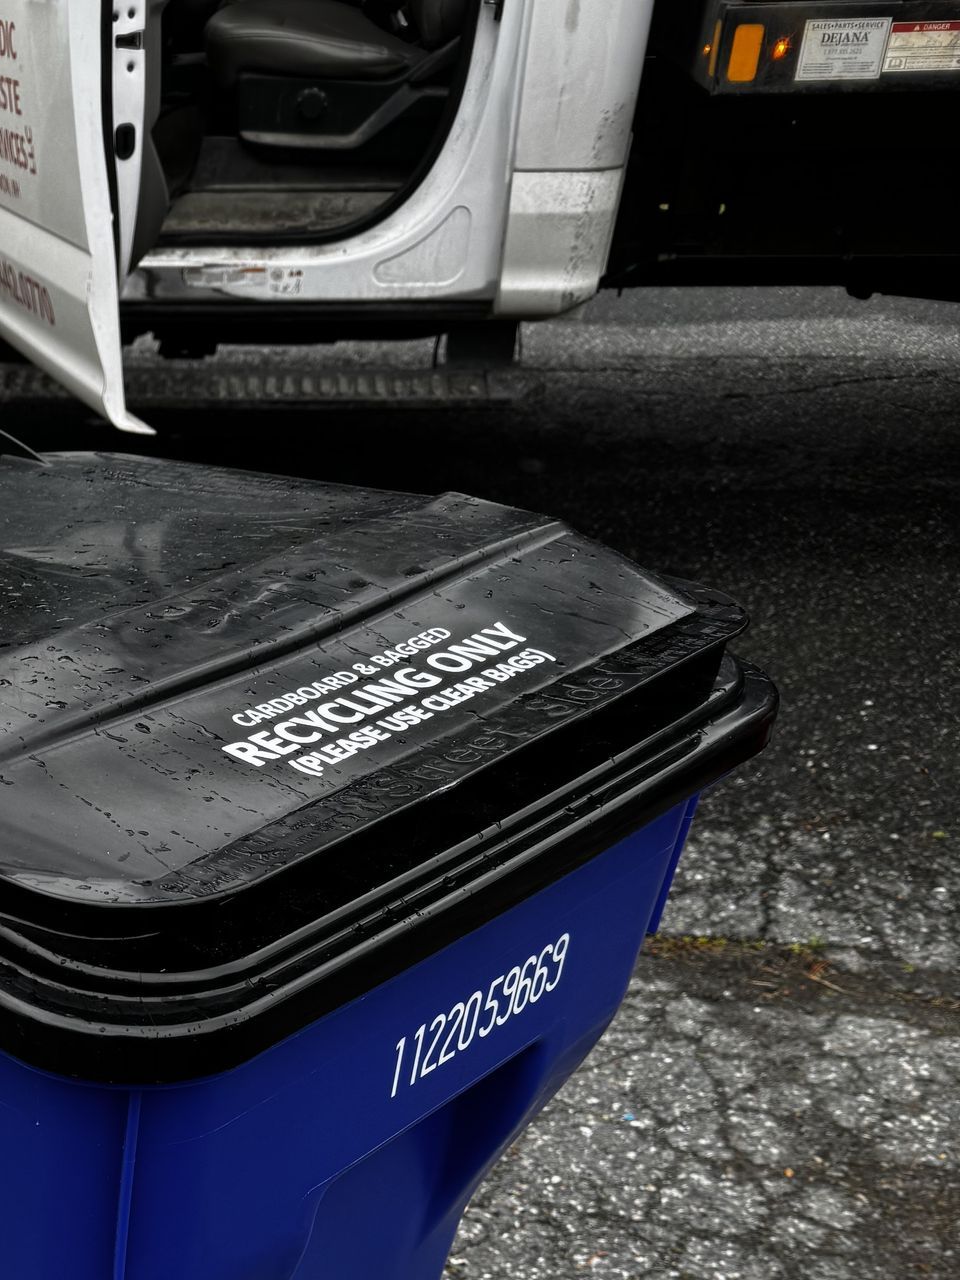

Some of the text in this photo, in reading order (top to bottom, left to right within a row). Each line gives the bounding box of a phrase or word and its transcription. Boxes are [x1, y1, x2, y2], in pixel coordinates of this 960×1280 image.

[821, 31, 869, 46] DEJANA
[923, 23, 951, 31] DANGER
[221, 667, 443, 767] RECYCLING
[426, 621, 527, 673] ONLY
[232, 627, 452, 727] CARDBOARD & BAGGED
[288, 647, 557, 777] (PLEASE USE CLEAR BAGS)
[391, 933, 570, 1098] 1122059669
